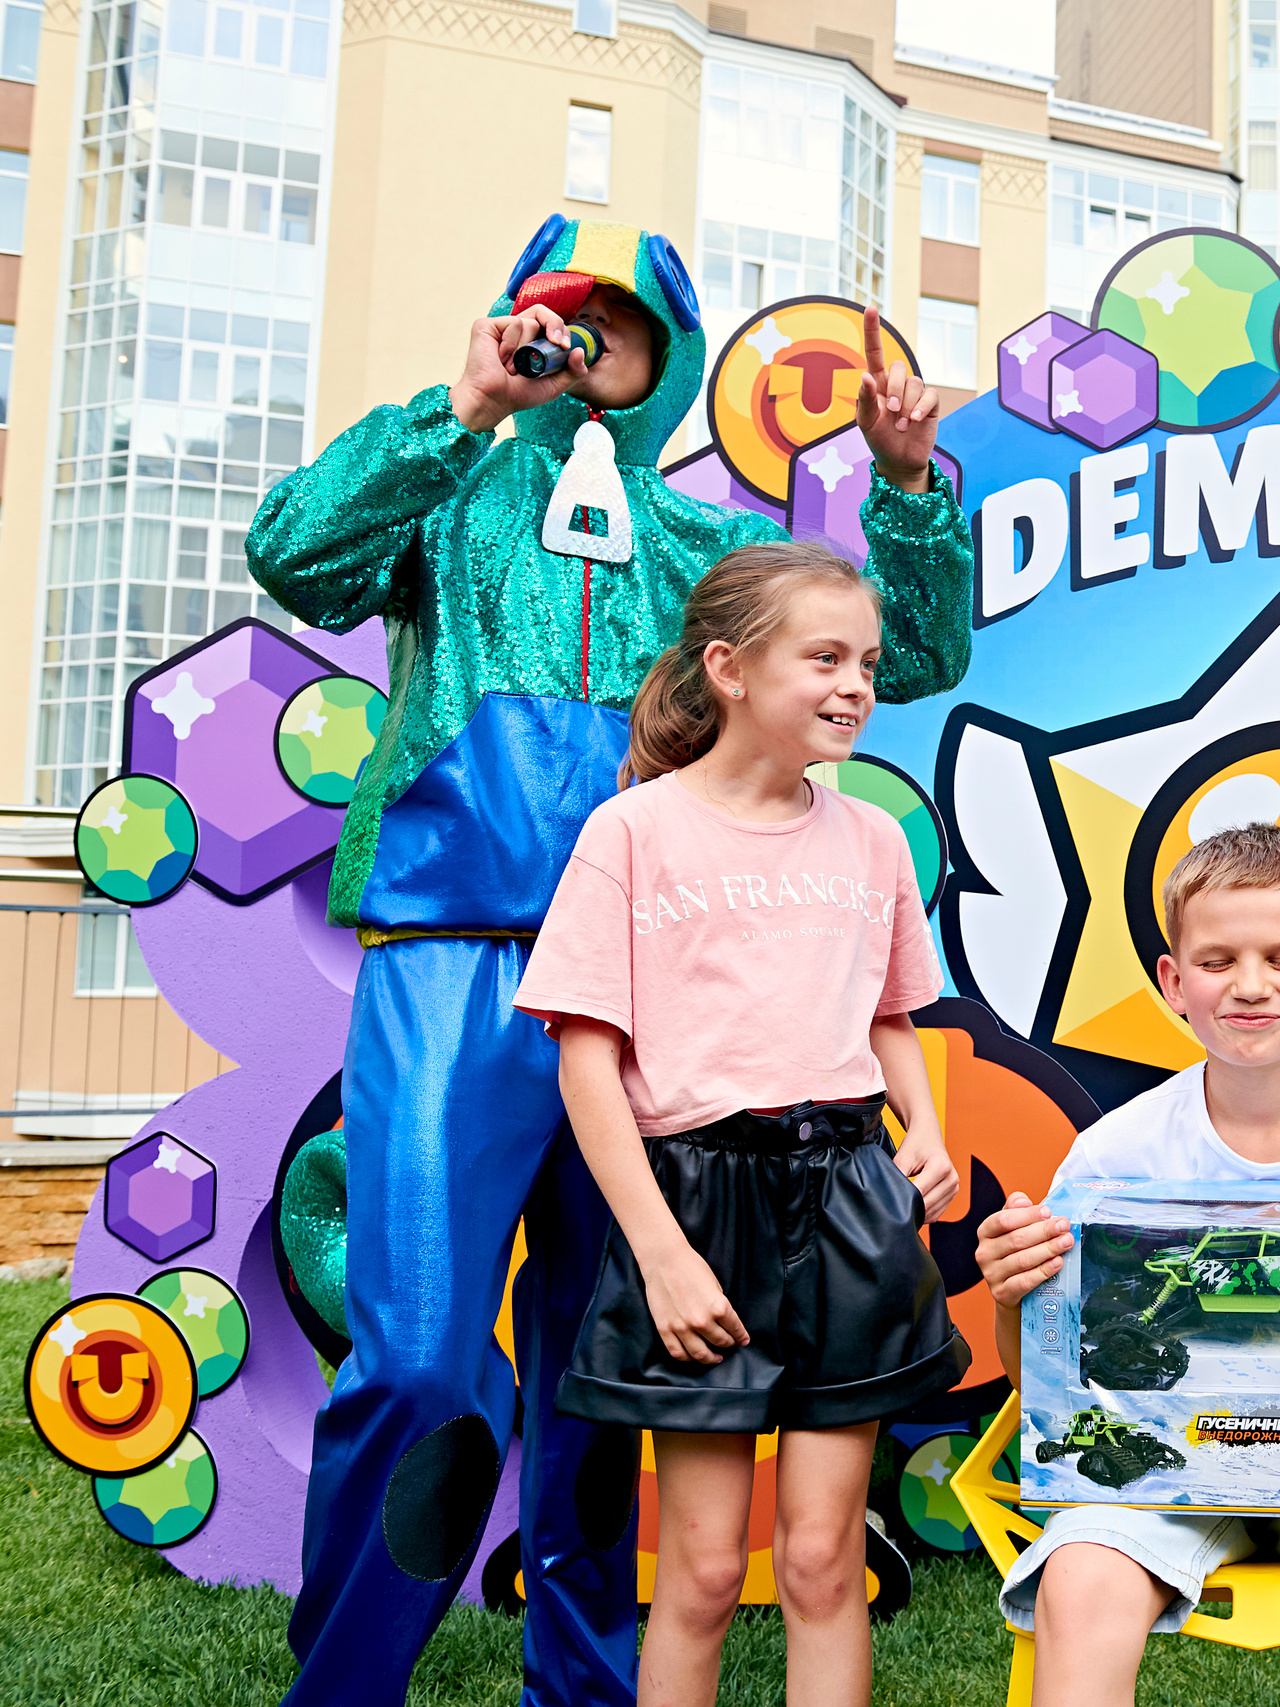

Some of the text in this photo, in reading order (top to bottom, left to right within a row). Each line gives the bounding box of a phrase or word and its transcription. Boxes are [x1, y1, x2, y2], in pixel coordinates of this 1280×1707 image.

[632, 879, 710, 934] SAN
[741, 927, 845, 940] ALAMO SQUARE
